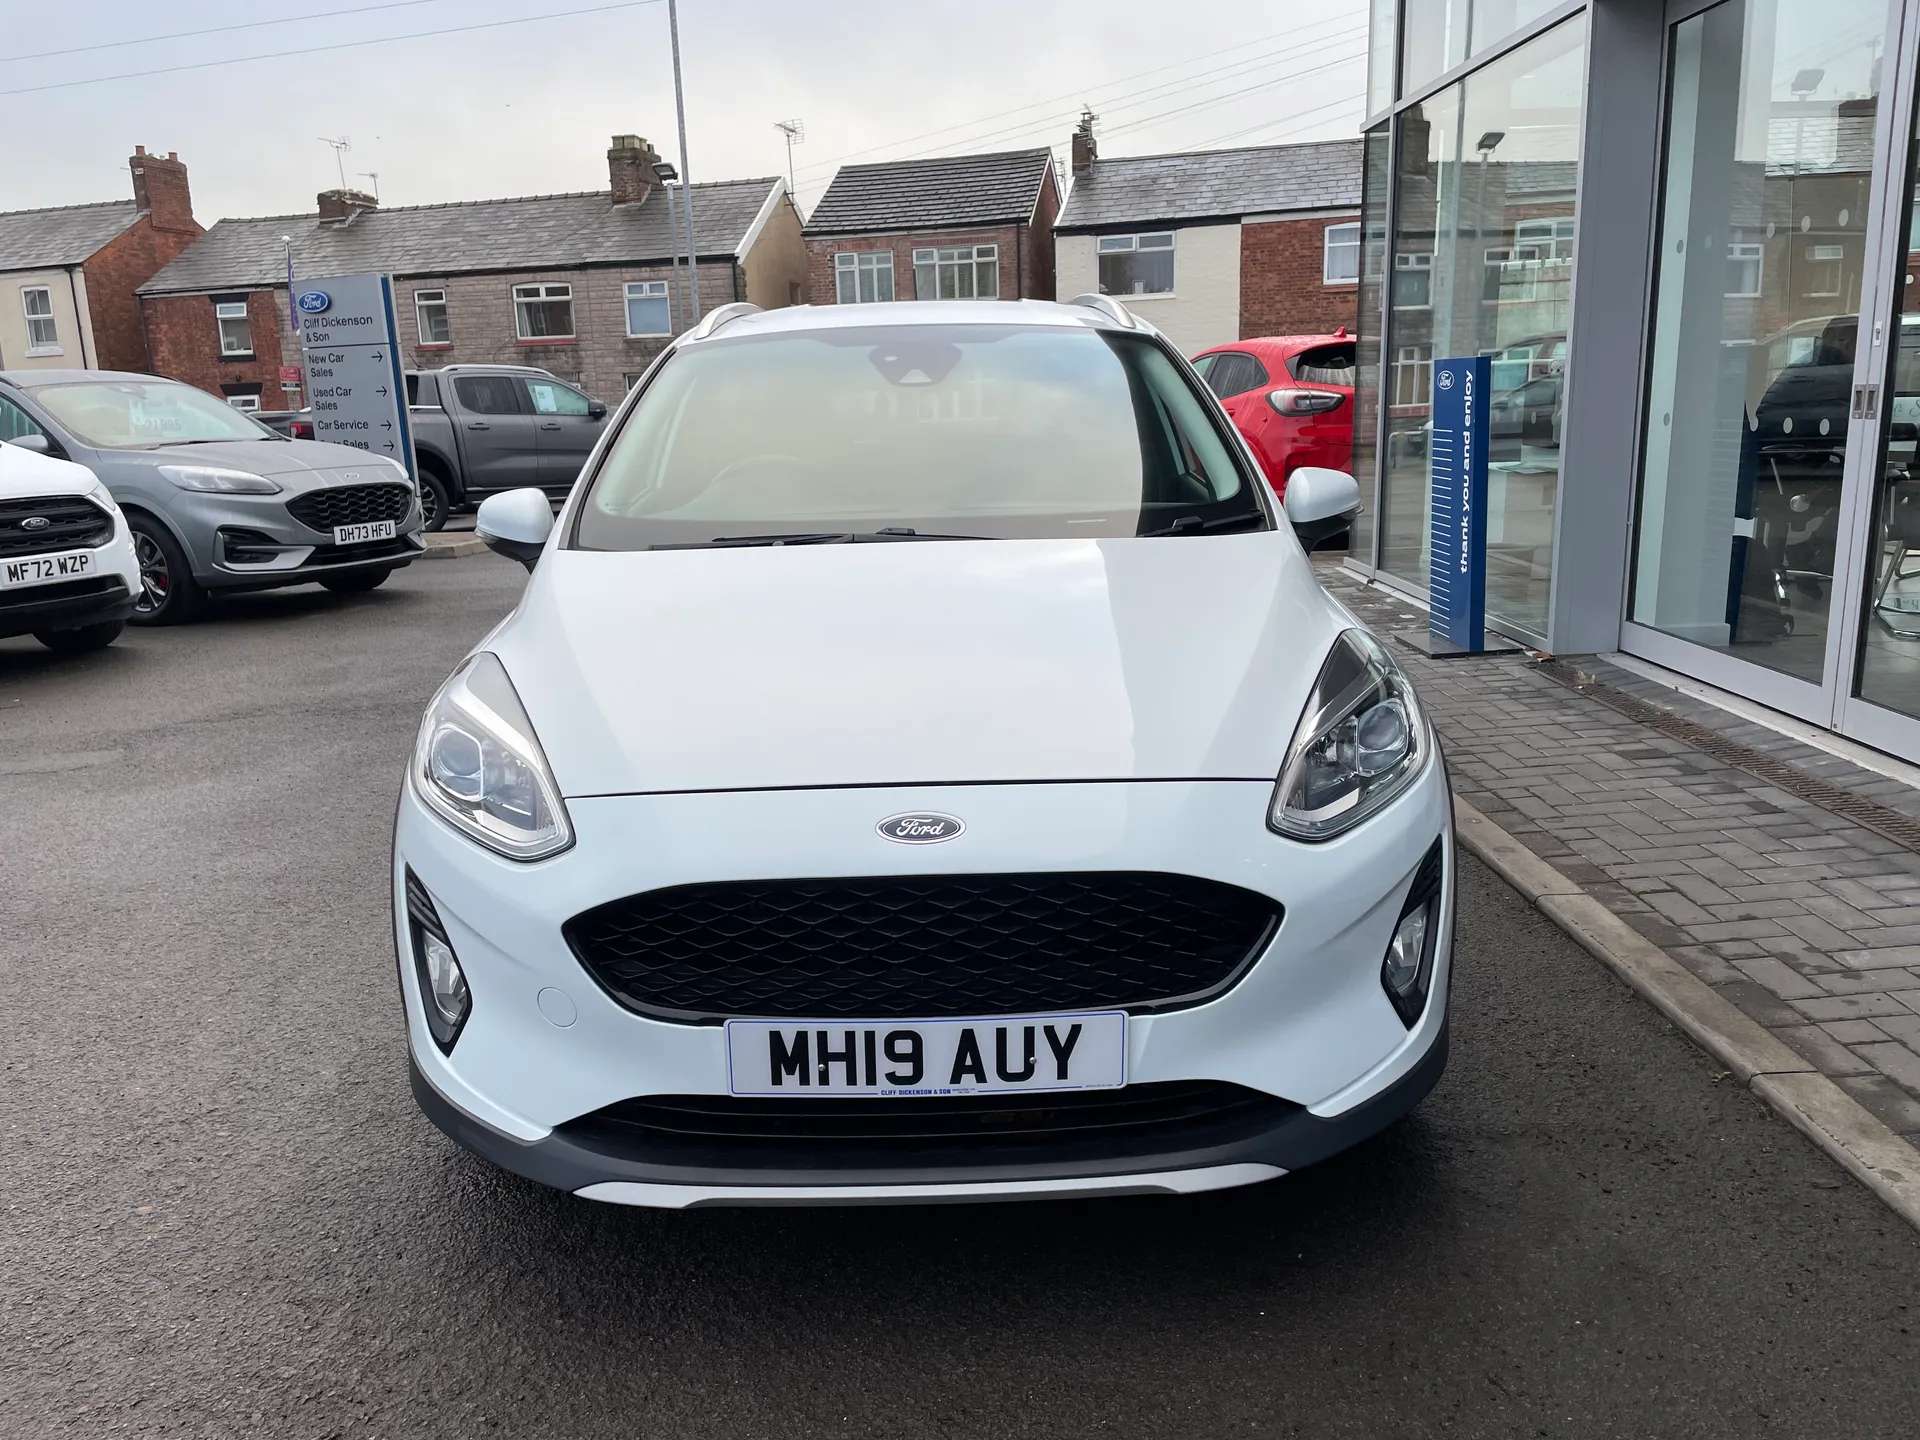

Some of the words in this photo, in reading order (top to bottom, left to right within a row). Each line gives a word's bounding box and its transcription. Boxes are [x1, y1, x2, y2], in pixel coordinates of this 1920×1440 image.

[304, 318, 320, 329] Cliff
[321, 315, 373, 328] Dickenson
[306, 333, 312, 342] &
[313, 332, 330, 342] Son
[308, 354, 327, 364] New
[328, 352, 344, 363] Car
[311, 367, 333, 378] Sales
[313, 387, 334, 398] Used
[335, 386, 352, 397] Car
[1464, 370, 1473, 427] enjoy
[315, 400, 338, 411] Sales
[318, 420, 332, 430] Car
[333, 419, 369, 430] Service
[1463, 431, 1471, 471] and
[1461, 475, 1470, 512] you
[340, 526, 369, 542] DH73
[371, 523, 392, 538] HFU
[1460, 518, 1472, 574] thank
[7, 560, 54, 582] MF72
[57, 555, 88, 574] WZP
[768, 1029, 924, 1087] MH19
[949, 1023, 1083, 1084] AUY
